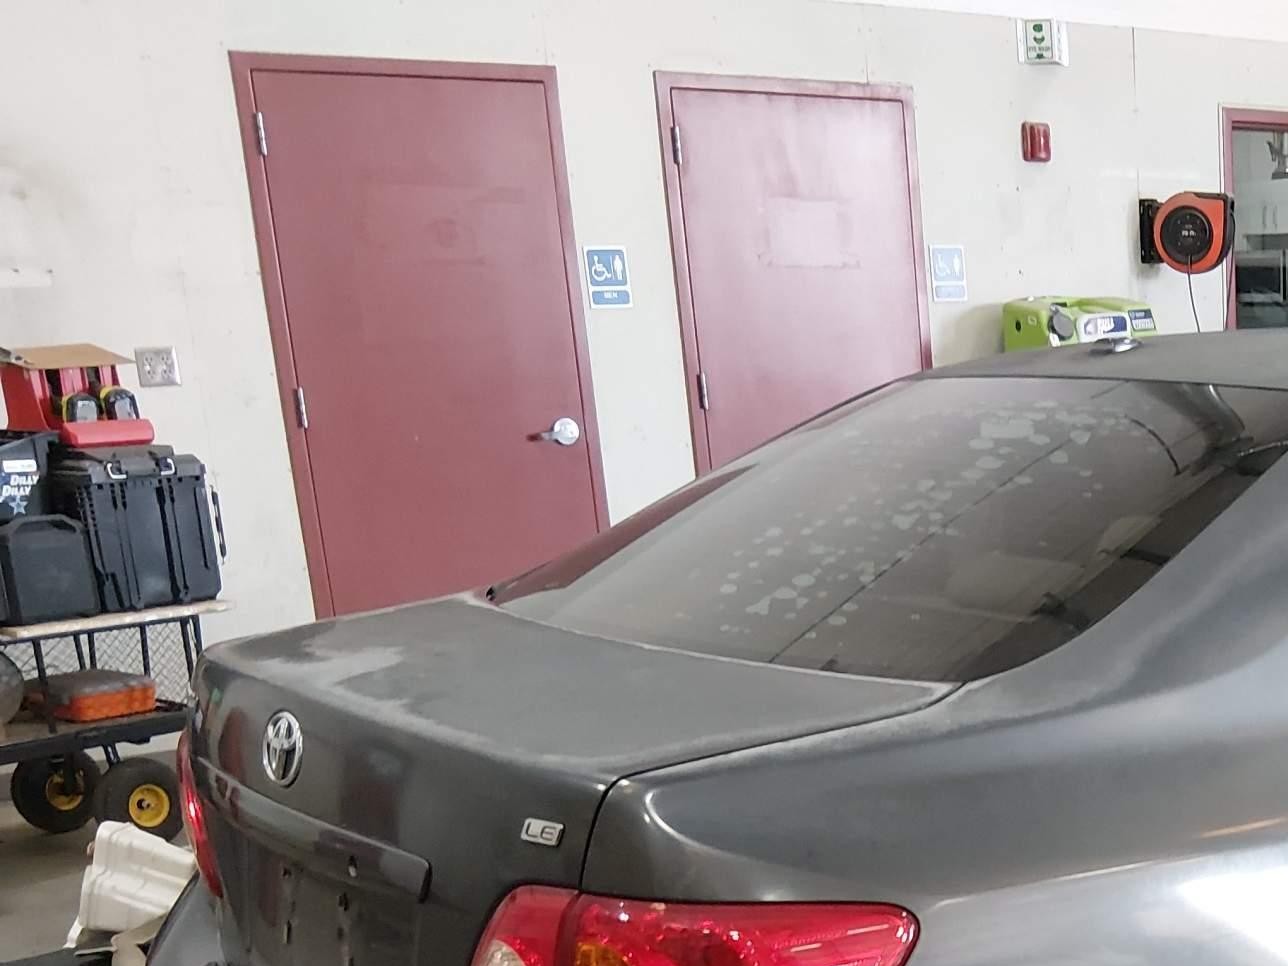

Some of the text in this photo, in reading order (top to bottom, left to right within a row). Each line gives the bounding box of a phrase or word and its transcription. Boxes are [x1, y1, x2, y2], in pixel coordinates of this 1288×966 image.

[9, 473, 40, 486] DILLY
[2, 484, 32, 497] DILLY
[525, 821, 558, 842] LE
